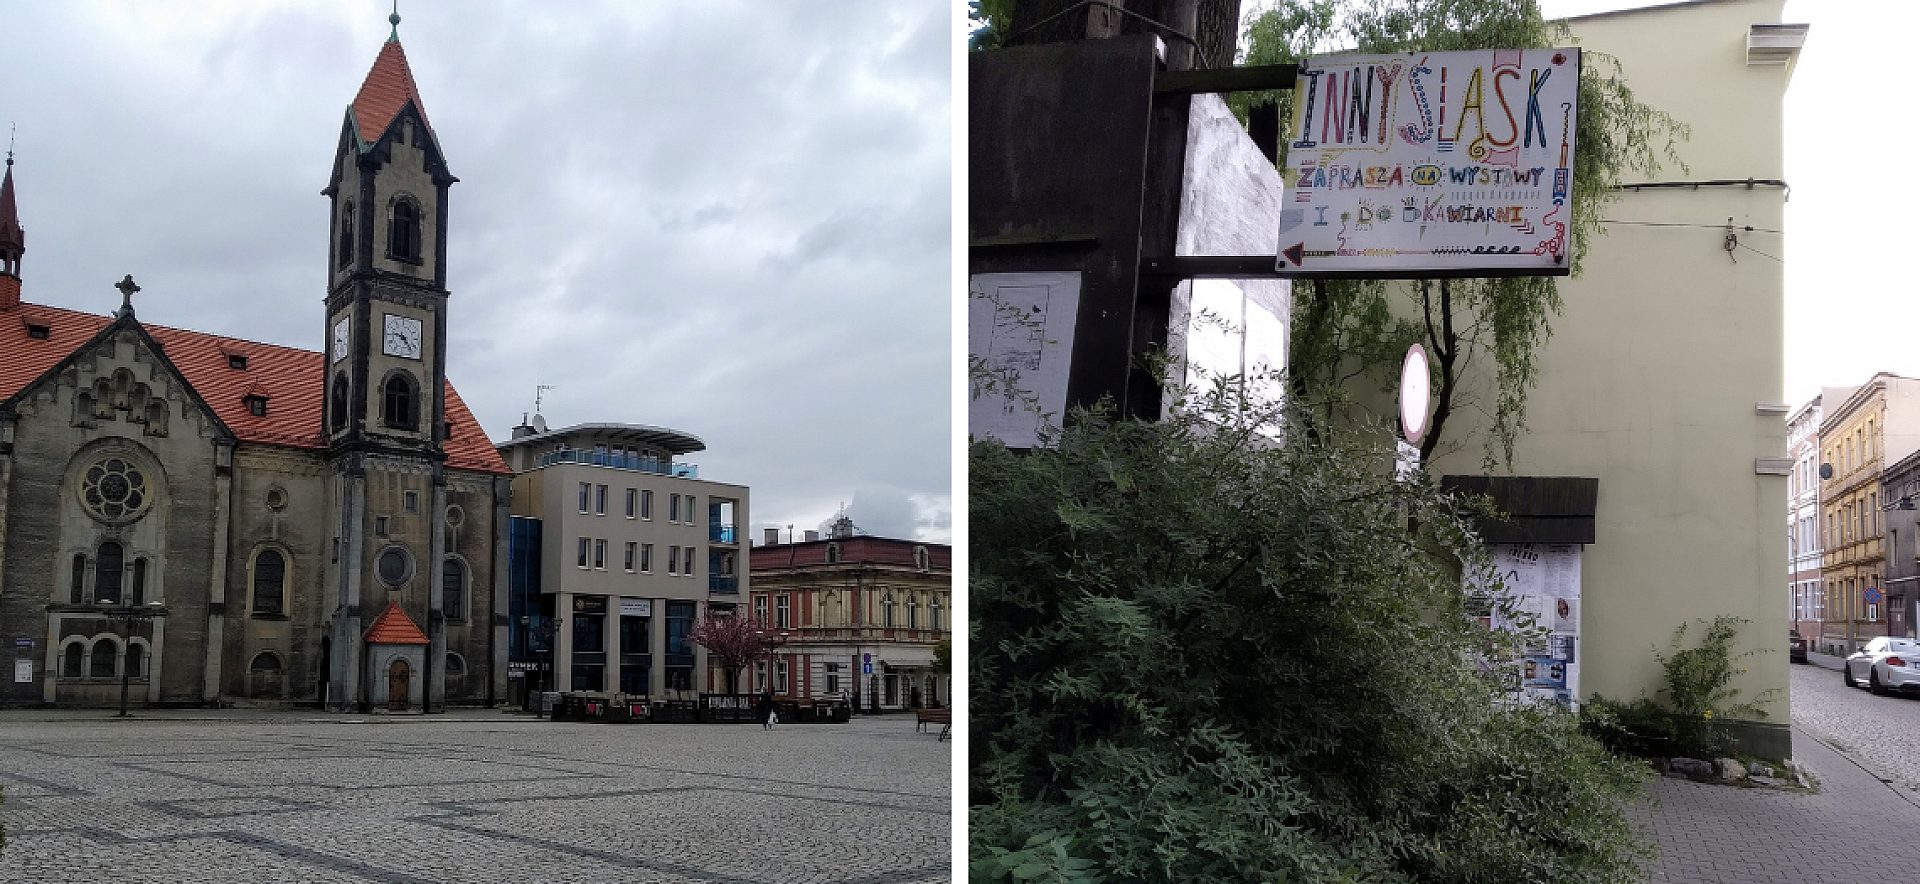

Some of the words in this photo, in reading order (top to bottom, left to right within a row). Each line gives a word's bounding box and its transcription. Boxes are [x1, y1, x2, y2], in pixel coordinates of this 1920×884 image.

[1293, 64, 1401, 149] INNY
[1297, 164, 1403, 188] ZAPRASZA
[1450, 166, 1545, 187] WYSTAWY
[1314, 206, 1328, 226] I
[1358, 205, 1393, 224] DO
[1422, 203, 1524, 223] KAWIARNI
